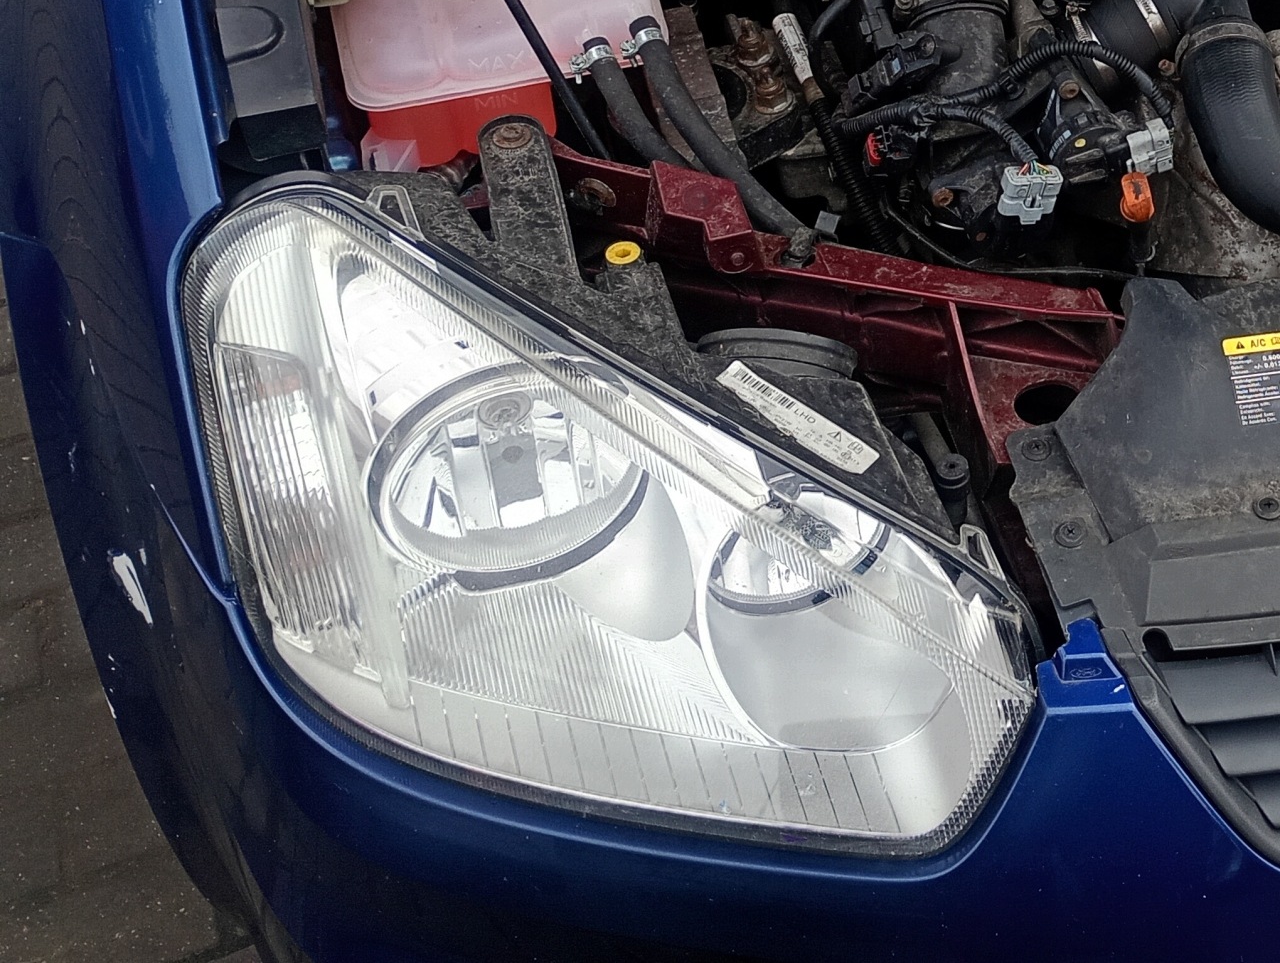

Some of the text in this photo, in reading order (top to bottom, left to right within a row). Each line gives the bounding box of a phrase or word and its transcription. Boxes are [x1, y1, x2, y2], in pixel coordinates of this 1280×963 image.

[468, 50, 526, 74] MAX
[473, 92, 518, 111] MIN
[1250, 338, 1267, 348] A/C
[794, 408, 816, 424] LHD
